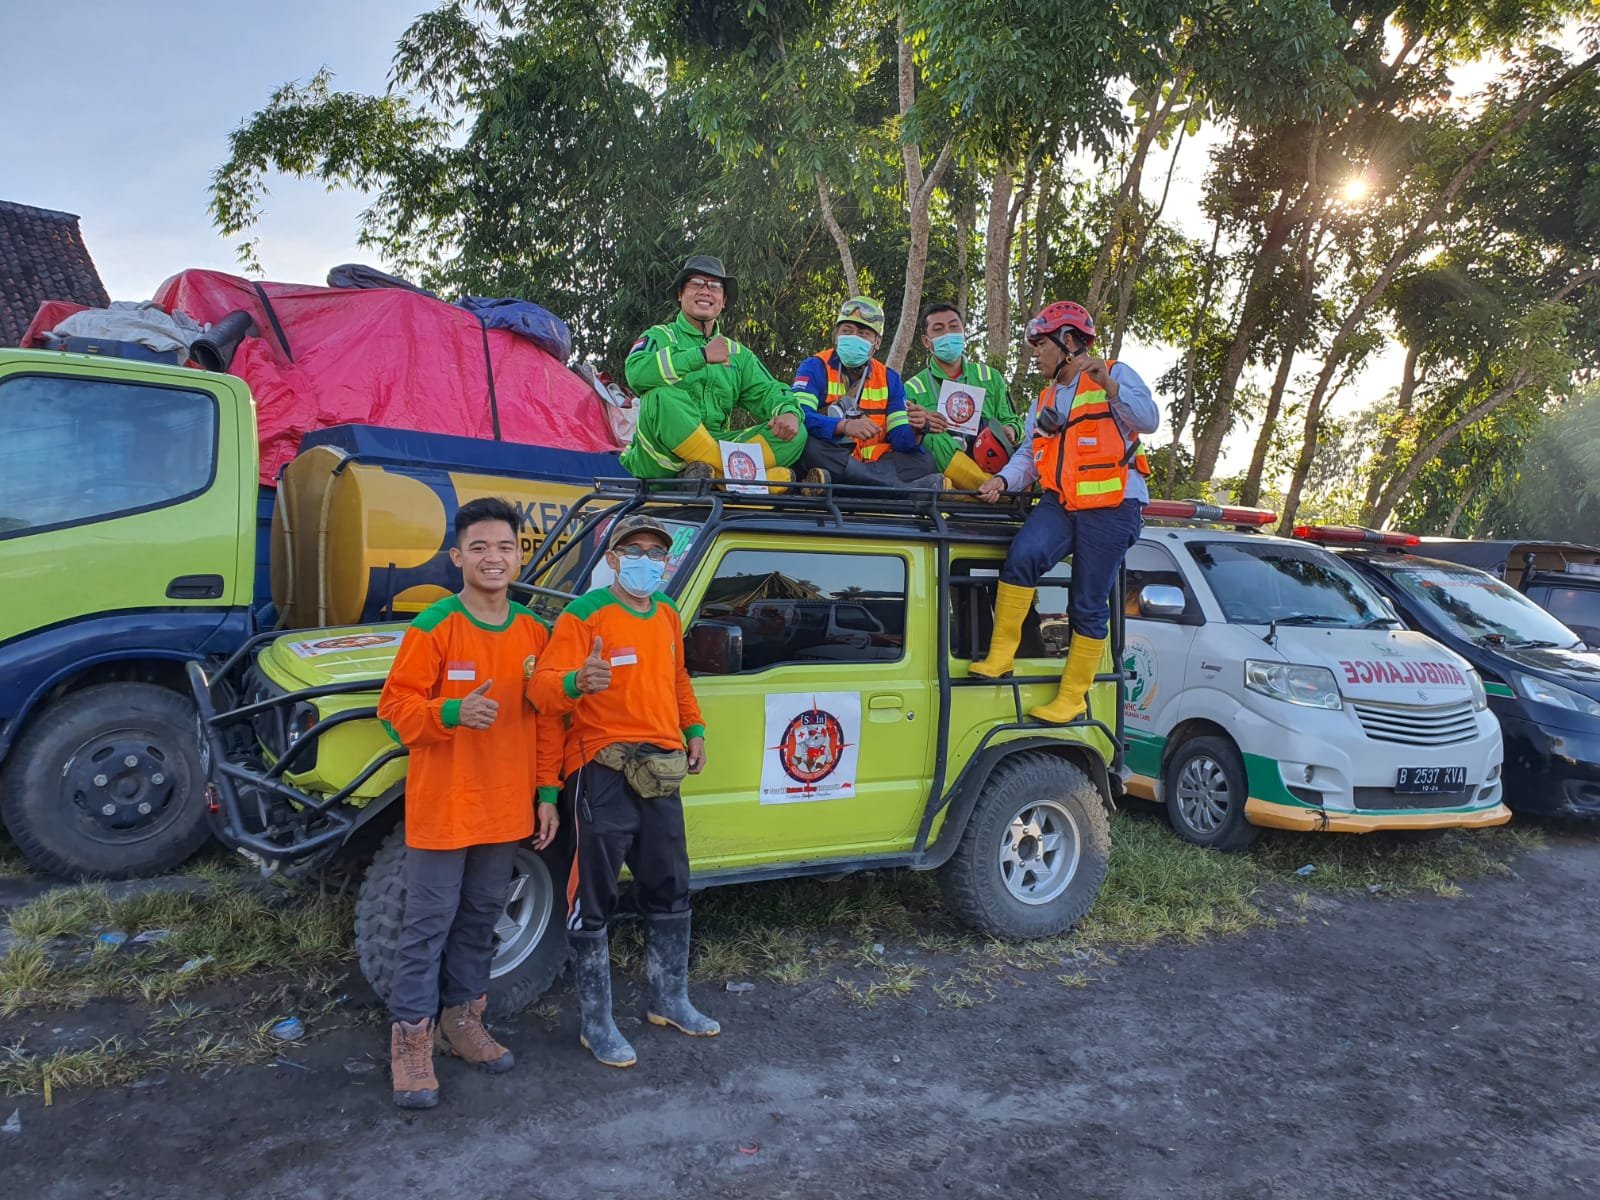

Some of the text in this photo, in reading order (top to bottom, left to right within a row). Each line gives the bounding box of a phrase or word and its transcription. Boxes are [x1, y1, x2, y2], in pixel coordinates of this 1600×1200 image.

[1400, 767, 1463, 784] B 2537 KVA
